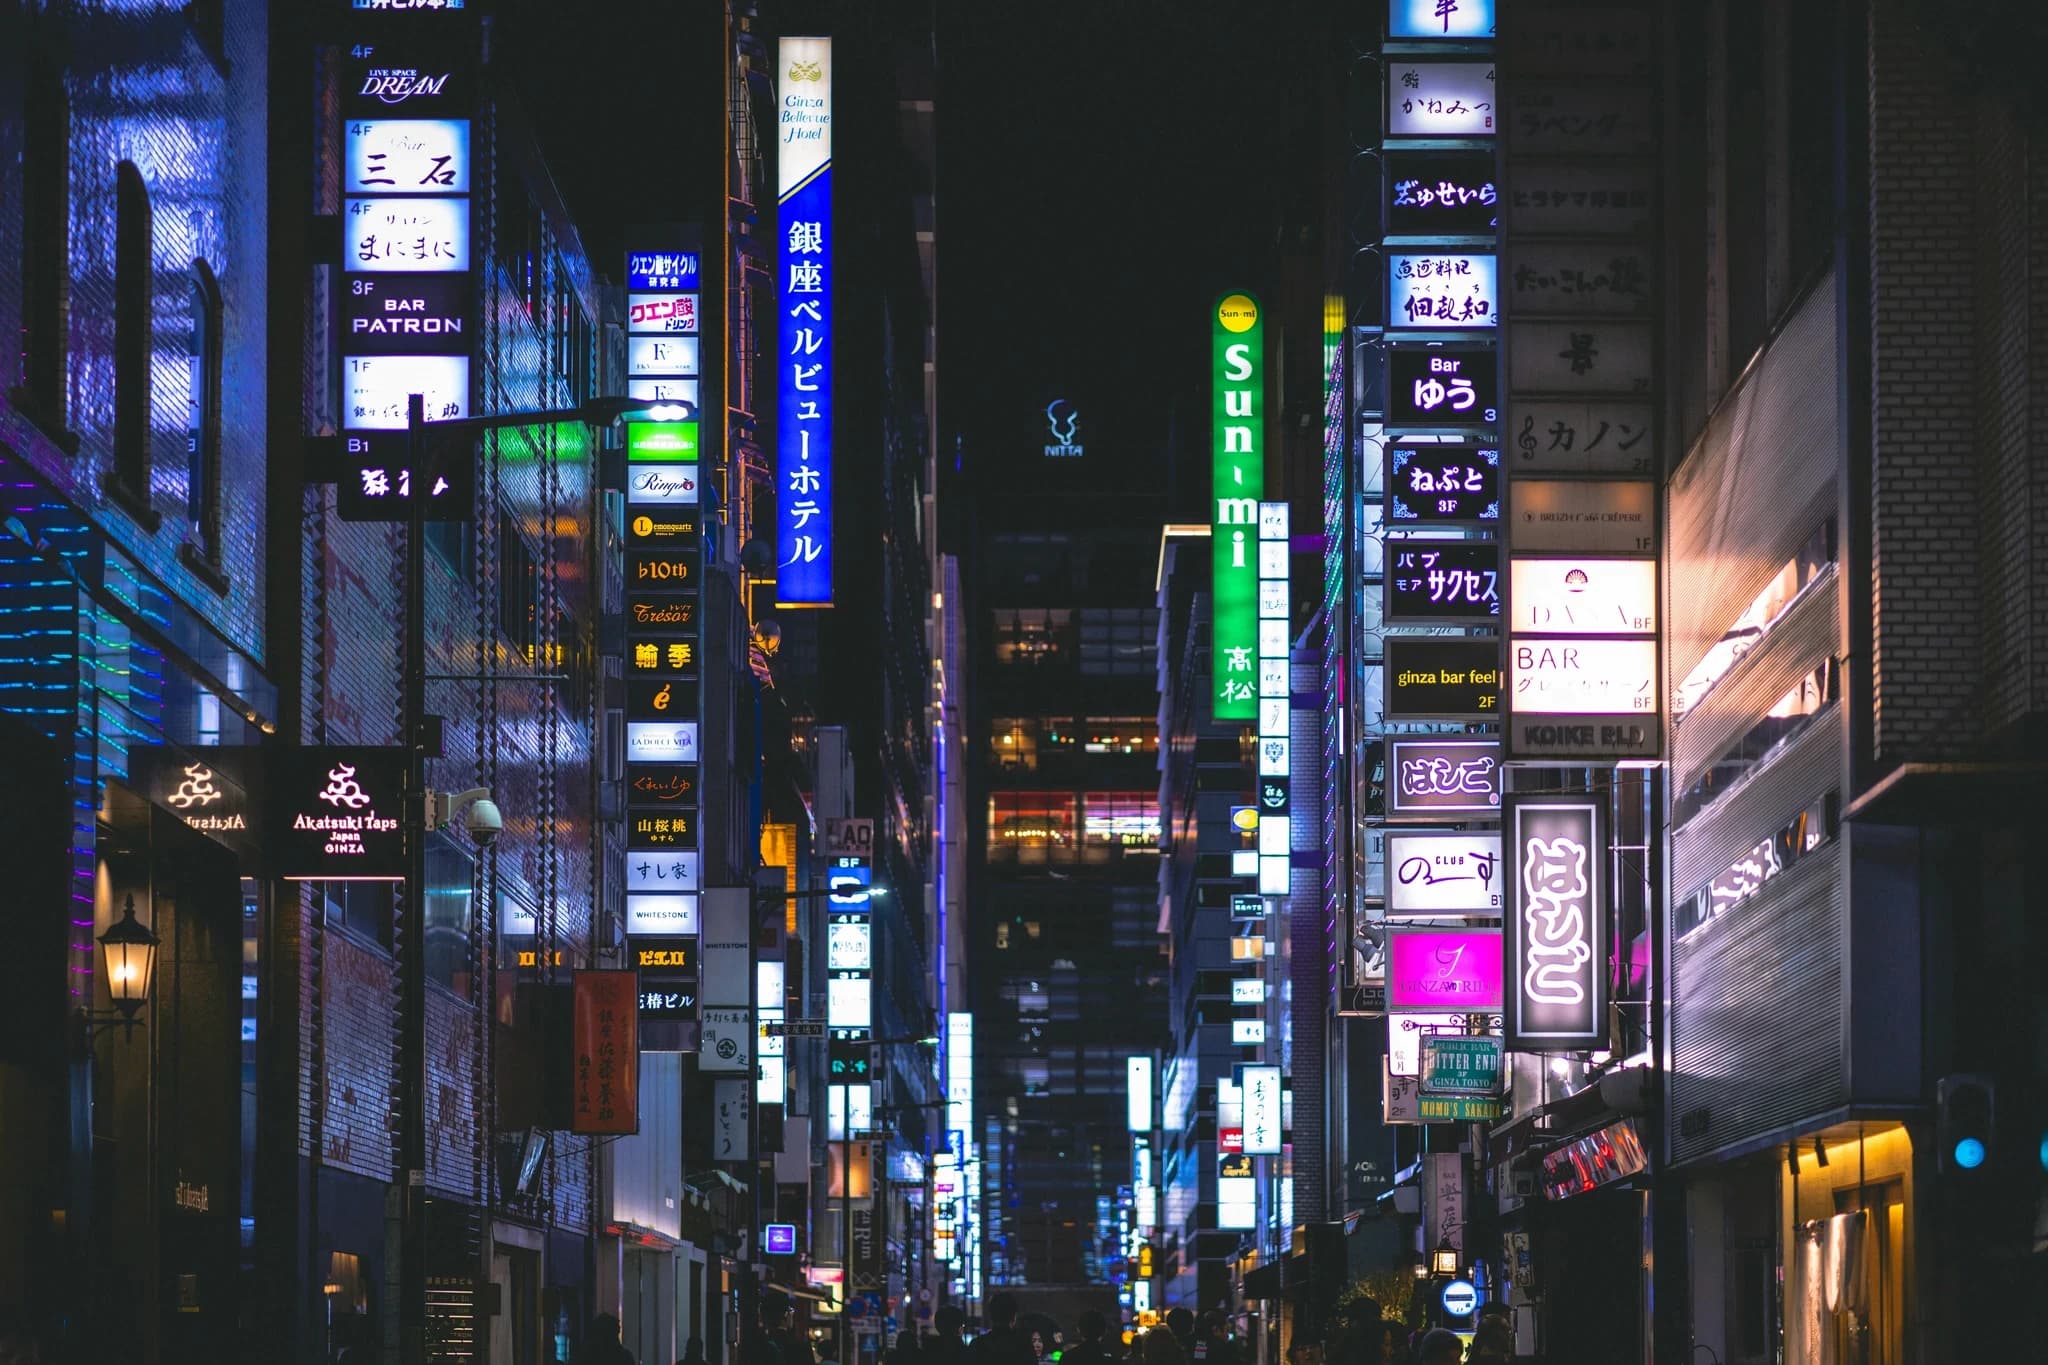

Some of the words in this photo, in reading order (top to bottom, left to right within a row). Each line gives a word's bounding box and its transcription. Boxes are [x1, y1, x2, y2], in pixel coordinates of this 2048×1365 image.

[352, 45, 373, 58] 4F
[359, 73, 449, 103] DREAM
[785, 95, 824, 107] Ginza
[1402, 98, 1491, 114] かねみつ
[781, 111, 830, 124] Bellevue
[352, 124, 372, 135] 4F
[784, 127, 821, 143] Hotel
[351, 205, 372, 215] 4F
[359, 235, 457, 260] まにまに
[353, 281, 374, 295] 3F
[648, 277, 679, 287] 研究会
[385, 300, 425, 311] BAR
[631, 298, 694, 323] クエン酸
[353, 319, 462, 333] PATRON
[665, 319, 694, 330] ドリンク
[352, 360, 371, 373] 1F
[1430, 358, 1460, 372] Bar
[788, 220, 824, 563] 銀座ベルビューホテル
[1414, 378, 1476, 409] ゆう
[1484, 409, 1496, 421] 3
[1548, 421, 1648, 452] カノン
[349, 439, 368, 452] B1
[1044, 445, 1083, 457] NITTA
[1410, 467, 1483, 492] ねぷと
[1439, 500, 1457, 512] 3F
[1636, 537, 1651, 549] 1F
[1398, 553, 1440, 568] パブ
[1396, 579, 1422, 591] モア
[1428, 570, 1498, 601] サクセス
[1490, 603, 1500, 614] 2
[1634, 617, 1651, 629] BF
[1518, 647, 1580, 669] BAR
[1220, 645, 1257, 704] 高松
[1398, 671, 1436, 687] ginza
[1441, 670, 1465, 684] bar
[1469, 670, 1496, 684] feel
[1479, 696, 1496, 708] 2F
[1634, 697, 1651, 708] BF
[1525, 726, 1595, 746] KOIKE
[1403, 757, 1494, 794] はしご
[293, 813, 362, 831] Akatsuki
[364, 810, 397, 832] Taps
[638, 819, 686, 832] 山桜桃
[330, 832, 360, 842] Japan
[325, 844, 365, 853] GINZA
[1435, 856, 1464, 865] CLUB
[637, 862, 687, 879] すし家
[1524, 837, 1591, 1005] はしご
[639, 951, 685, 966] ピエロ
[1436, 1042, 1468, 1051] PUBLIC
[1471, 1043, 1490, 1051] BAR
[1475, 1054, 1496, 1070] END
[1435, 1078, 1459, 1087] GINZA
[1463, 1079, 1490, 1087] TOKYO
[1421, 1102, 1458, 1116] MOMO'S
